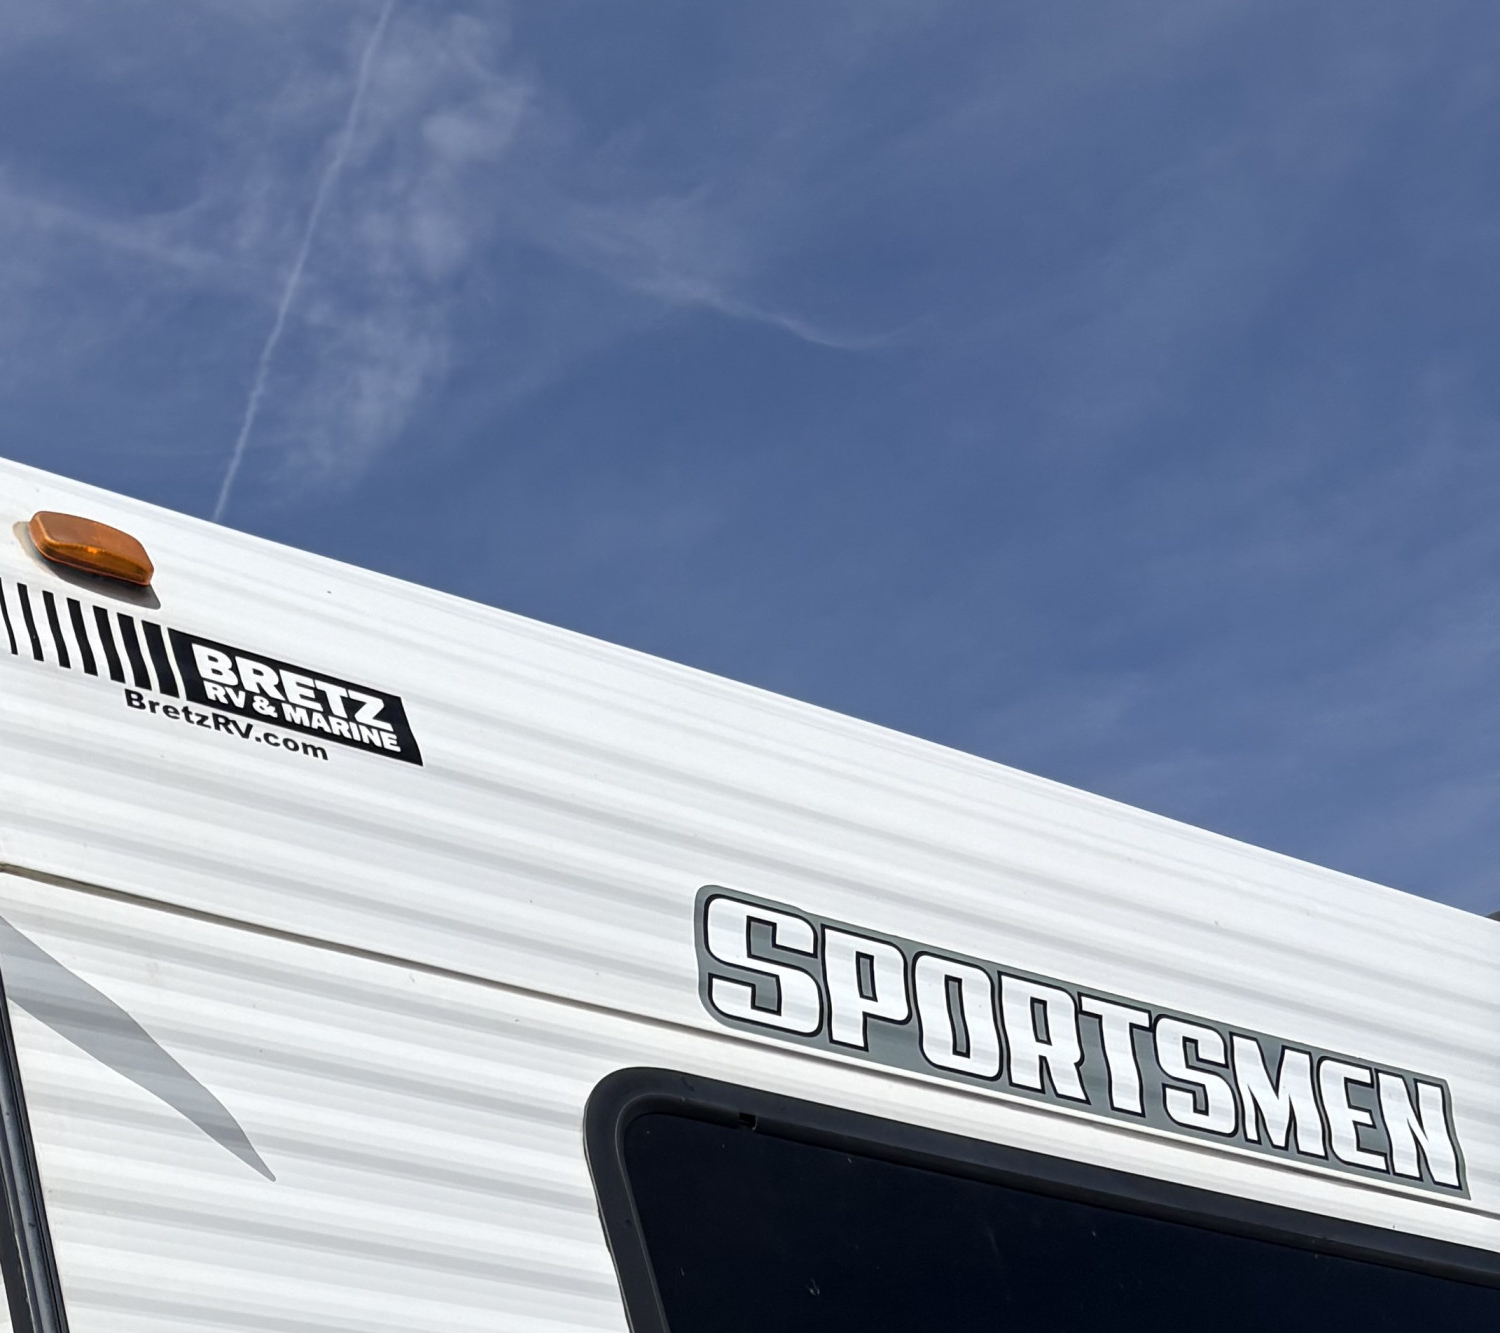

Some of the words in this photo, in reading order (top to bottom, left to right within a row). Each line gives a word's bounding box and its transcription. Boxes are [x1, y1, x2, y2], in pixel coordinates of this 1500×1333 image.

[124, 689, 329, 761] BretzRV.com
[191, 643, 394, 732] BRETZ
[203, 680, 247, 713] RV
[251, 693, 278, 718] &
[280, 700, 402, 753] MARINE
[704, 893, 1462, 1190] SPORTSMEN
